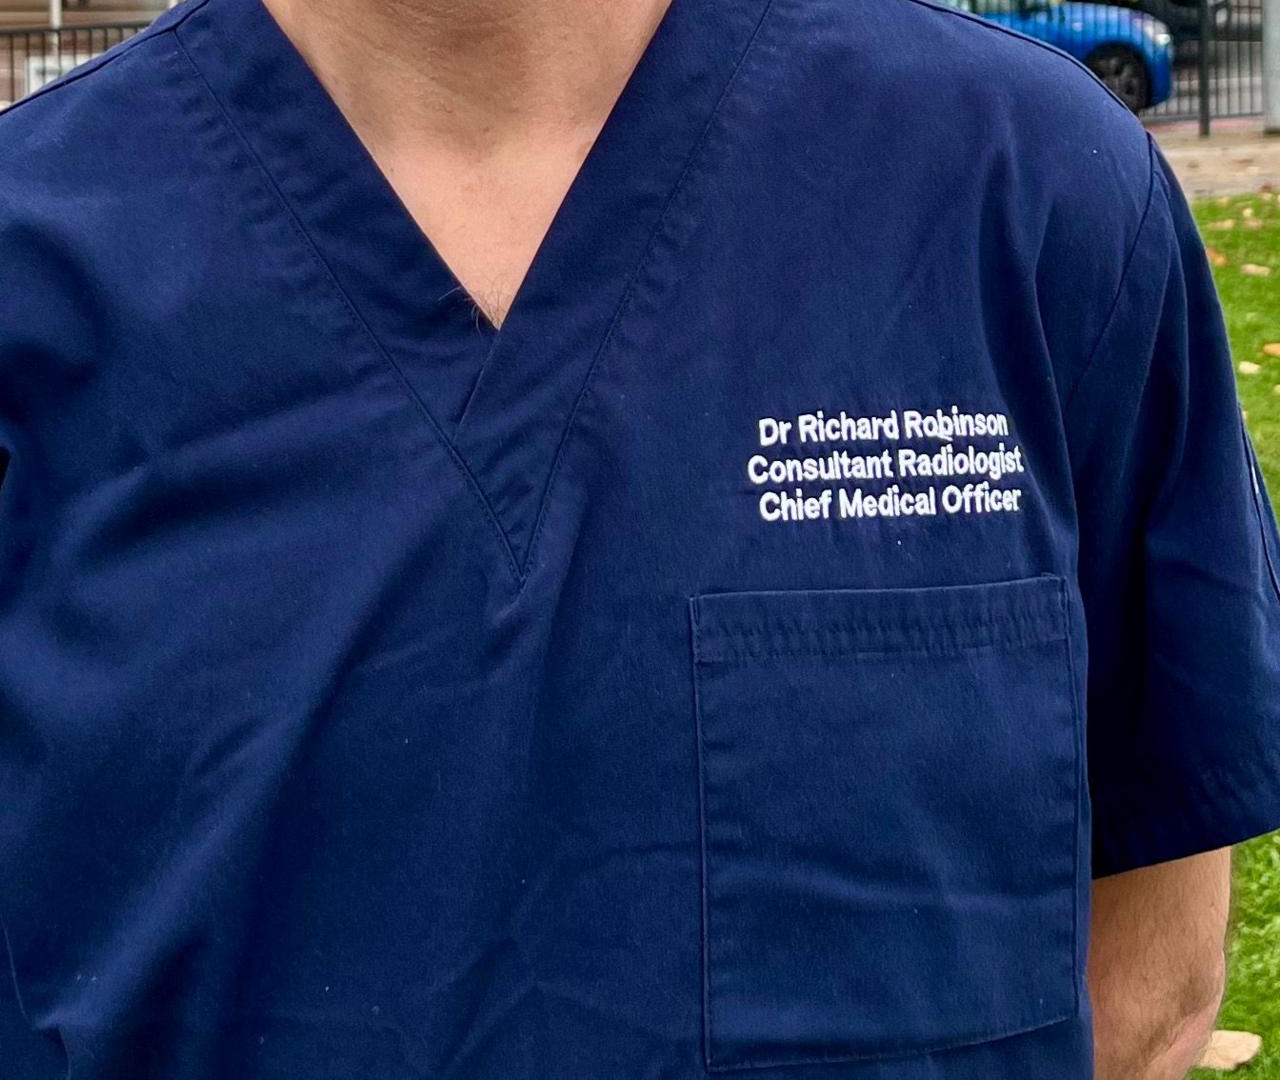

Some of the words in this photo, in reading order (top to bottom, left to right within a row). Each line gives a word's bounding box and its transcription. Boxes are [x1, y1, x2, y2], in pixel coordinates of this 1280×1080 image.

[759, 418, 792, 446] Dr
[798, 410, 899, 443] Richard
[903, 405, 1009, 440] Robinson
[747, 449, 894, 484] Consultant
[898, 442, 1024, 480] Radiologist
[759, 488, 832, 521] Chief
[838, 484, 936, 518] Medical
[942, 481, 1022, 514] Officer
